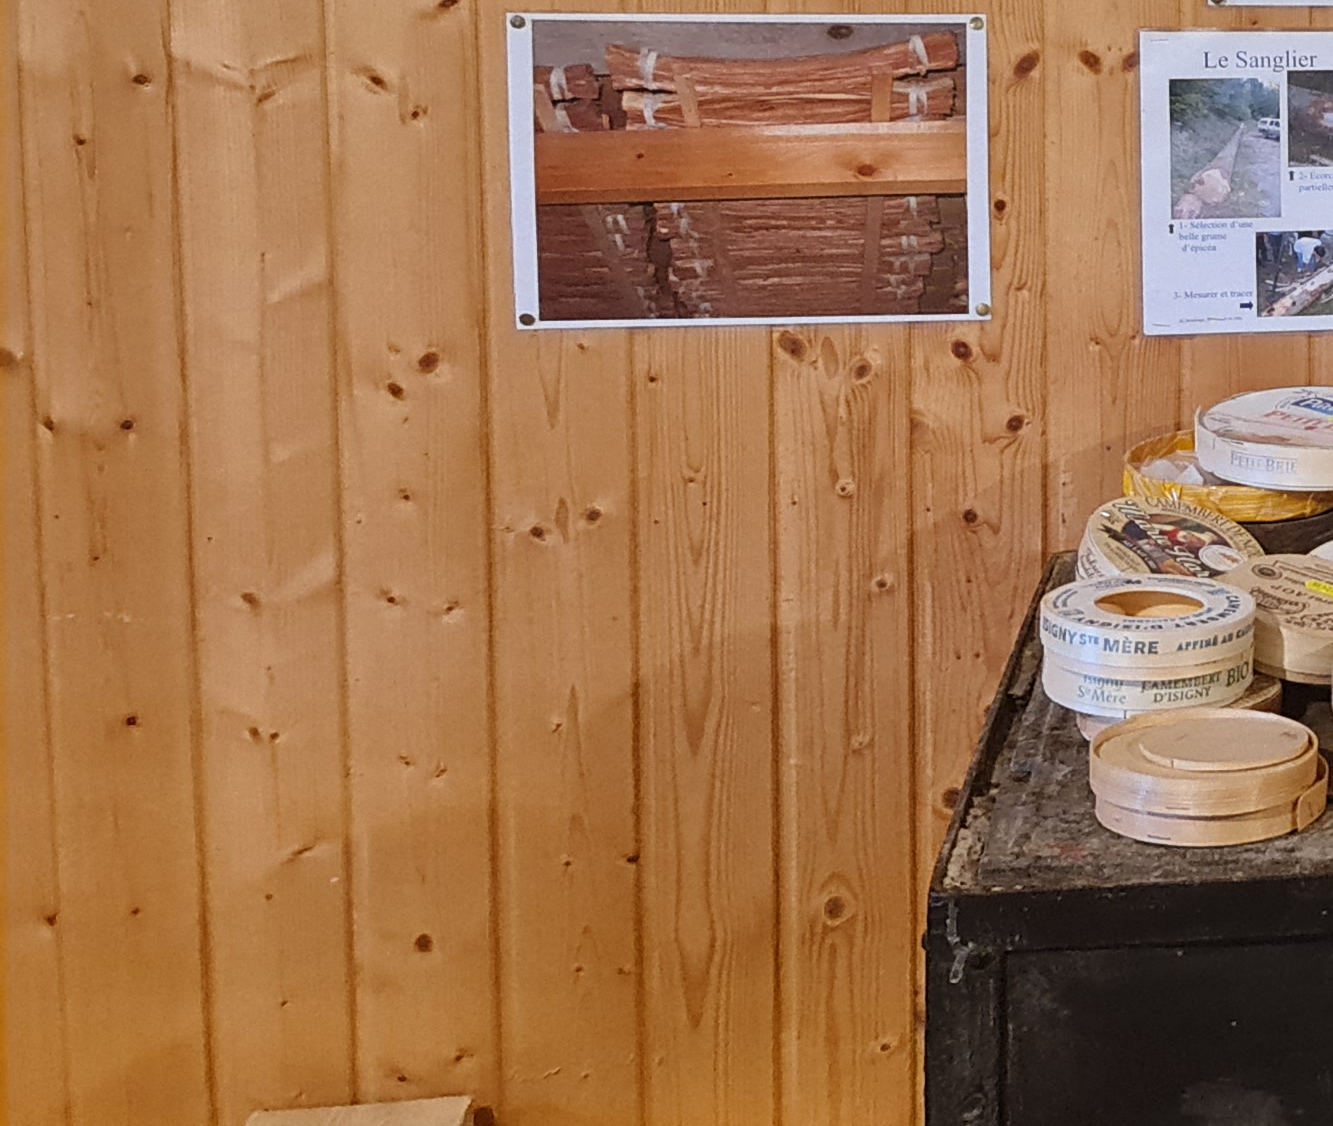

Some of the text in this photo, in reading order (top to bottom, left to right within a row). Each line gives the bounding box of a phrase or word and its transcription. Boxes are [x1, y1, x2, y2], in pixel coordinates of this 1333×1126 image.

[1204, 50, 1318, 73] Le Sanglier
[1190, 220, 1228, 230] Sélection
[1179, 232, 1196, 241] belle
[1221, 290, 1229, 298] et
[1230, 289, 1253, 298] tracer
[1265, 457, 1297, 474] BRIE
[1145, 497, 1230, 526] CAMEMBERT
[1103, 635, 1160, 655] MÈRE
[1141, 671, 1222, 693] CAMEMBERT
[1225, 661, 1250, 688] BIO
[1092, 687, 1127, 705] Mère
[1153, 686, 1213, 704] D'ISIGNY
